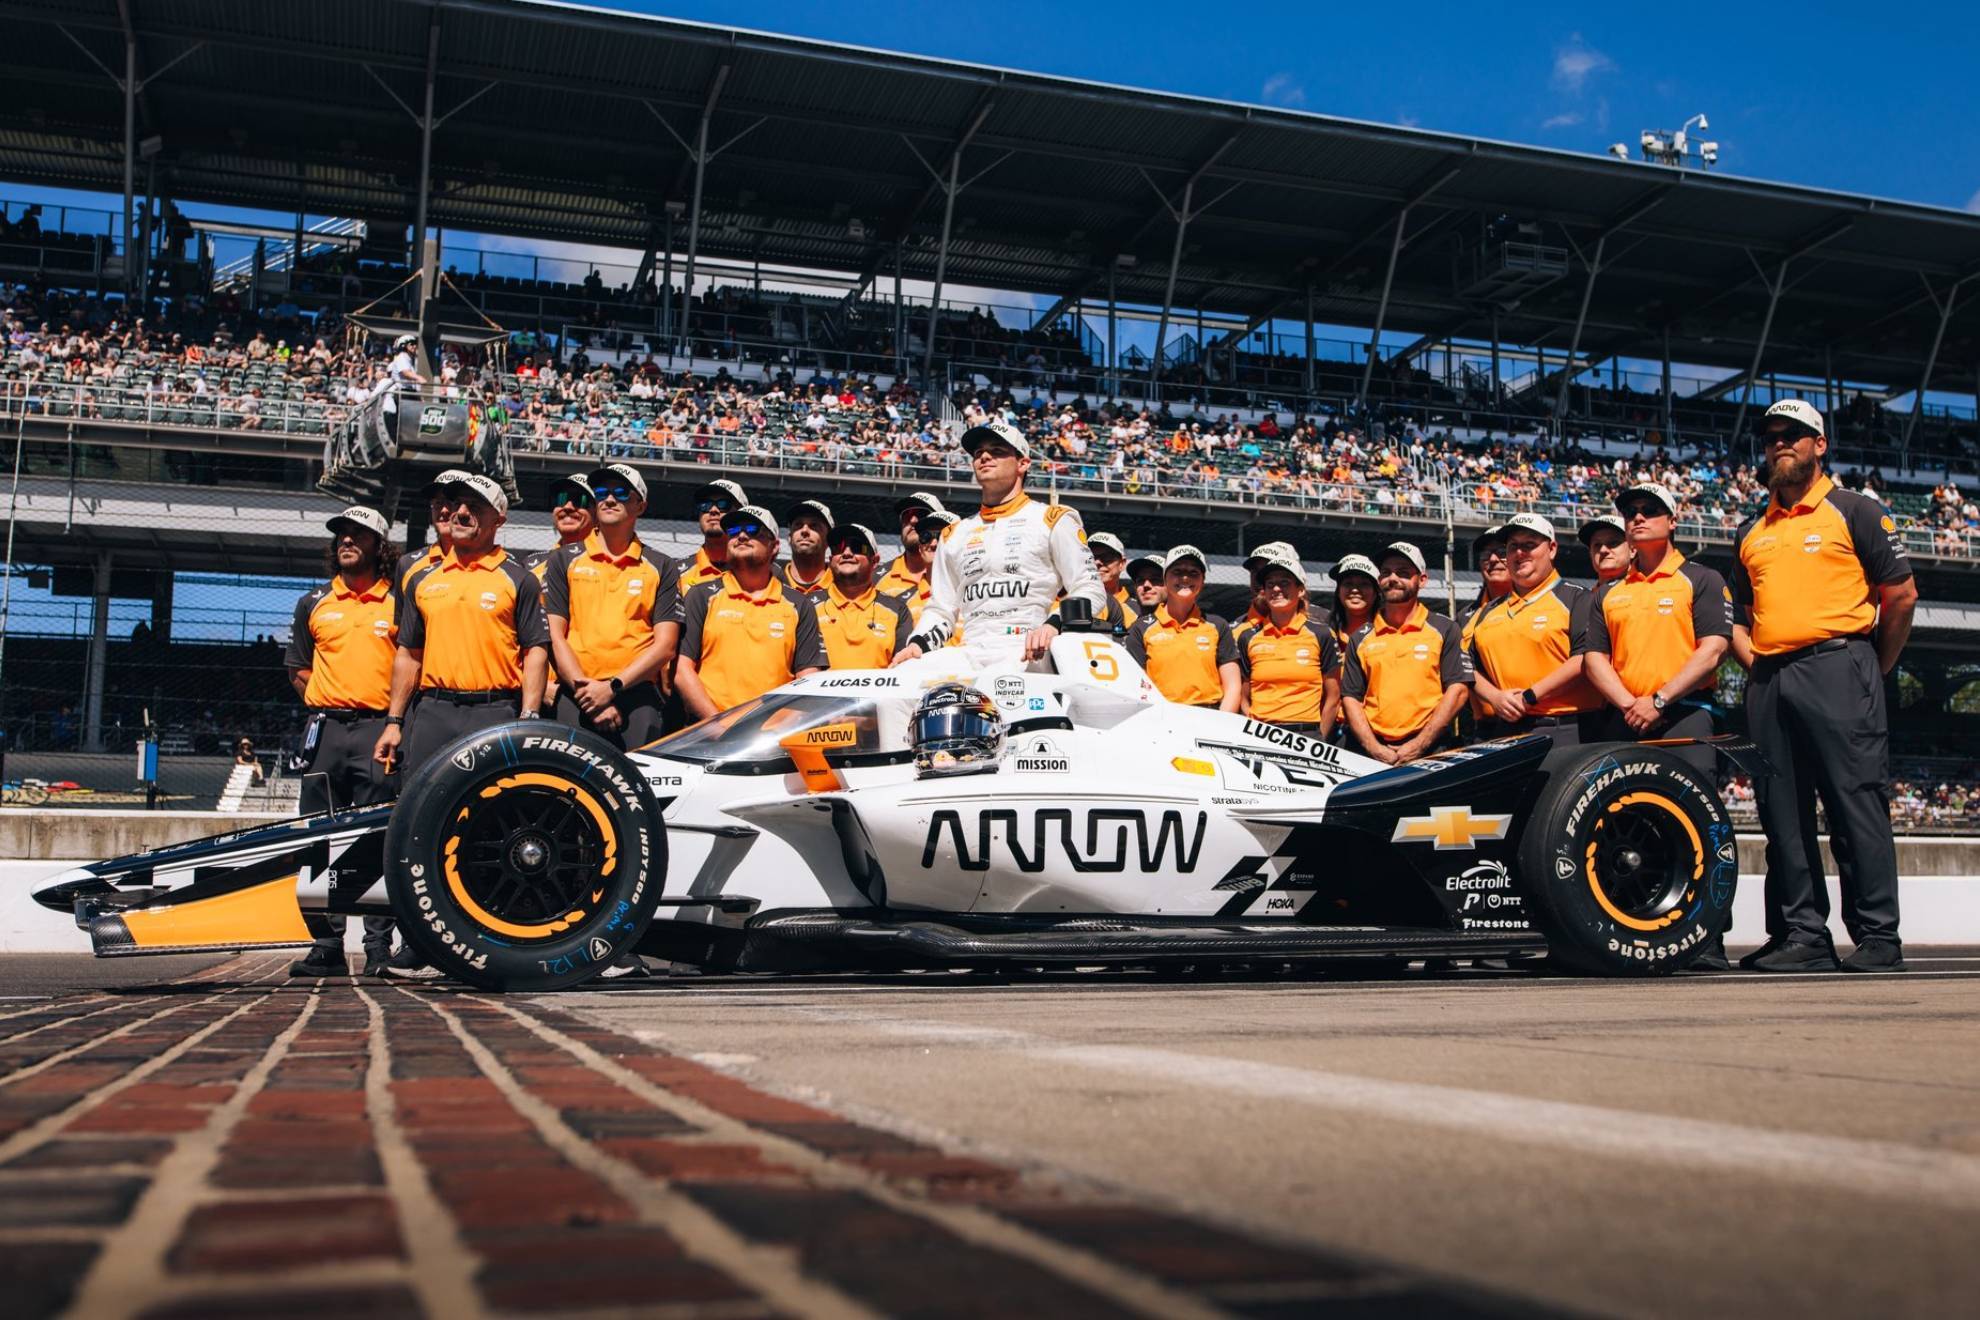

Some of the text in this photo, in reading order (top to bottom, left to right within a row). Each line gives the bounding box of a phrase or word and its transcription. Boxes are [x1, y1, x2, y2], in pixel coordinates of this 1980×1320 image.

[963, 581, 1030, 603] ARROW
[1083, 641, 1119, 681] 5
[820, 677, 900, 687] LUCAS OIL
[806, 730, 853, 743] ARROW
[1243, 719, 1307, 752] LUCAS
[1310, 742, 1341, 765] OIL
[522, 737, 644, 814] FIREHAWK
[1017, 759, 1067, 771] MISSION
[1565, 762, 1661, 838] FIREHAWK
[639, 827, 650, 869] INDY
[1446, 875, 1511, 891] Electrolit
[1267, 899, 1294, 909] HOKA
[1502, 897, 1521, 905] NTT
[410, 863, 488, 971] Firestone
[1462, 918, 1529, 929] Firestone
[1608, 924, 1708, 961] Firestone
